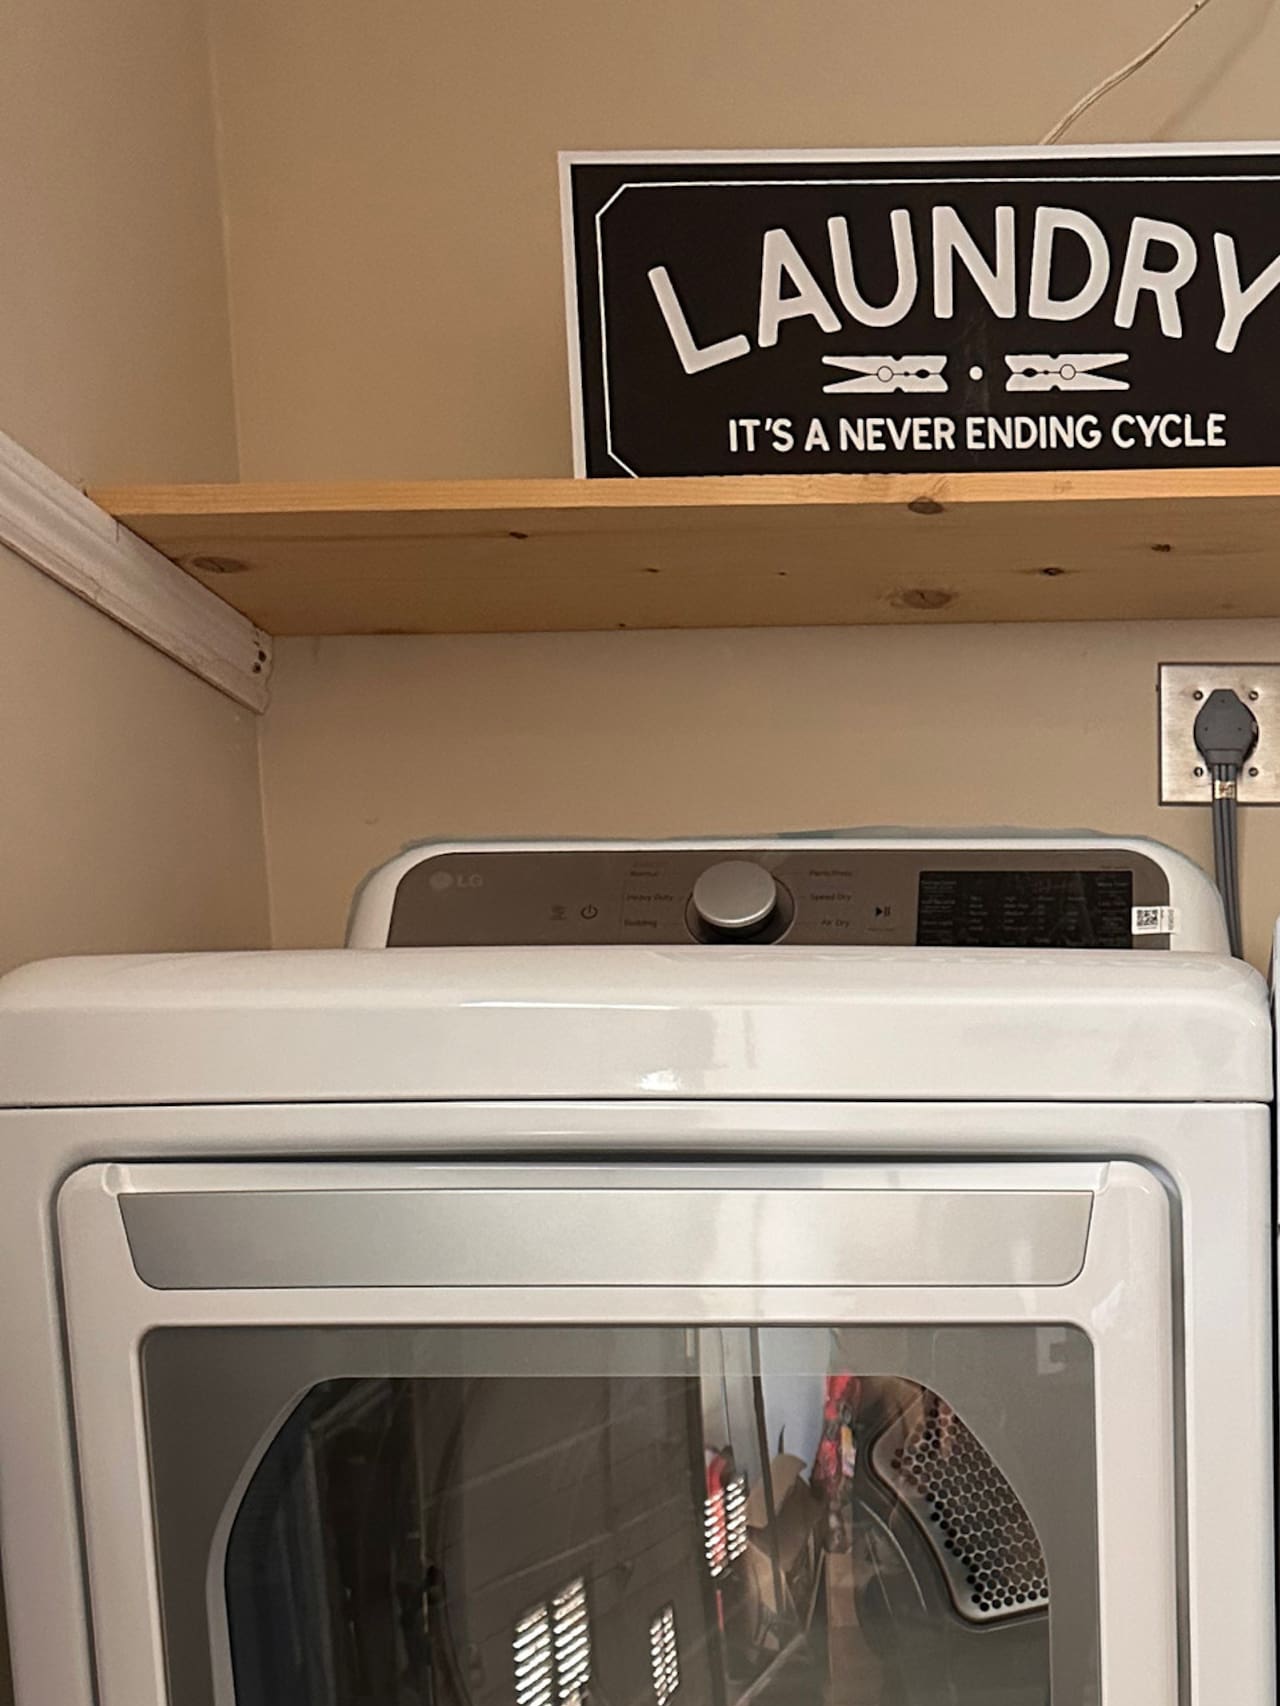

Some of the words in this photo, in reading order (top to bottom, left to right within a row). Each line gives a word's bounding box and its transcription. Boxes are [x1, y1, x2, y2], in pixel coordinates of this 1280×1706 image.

[728, 417, 794, 452] IT'S
[804, 417, 832, 451] A
[838, 416, 956, 451] NEVER
[968, 414, 1101, 450] ENDING
[1112, 412, 1228, 448] CYCLE
